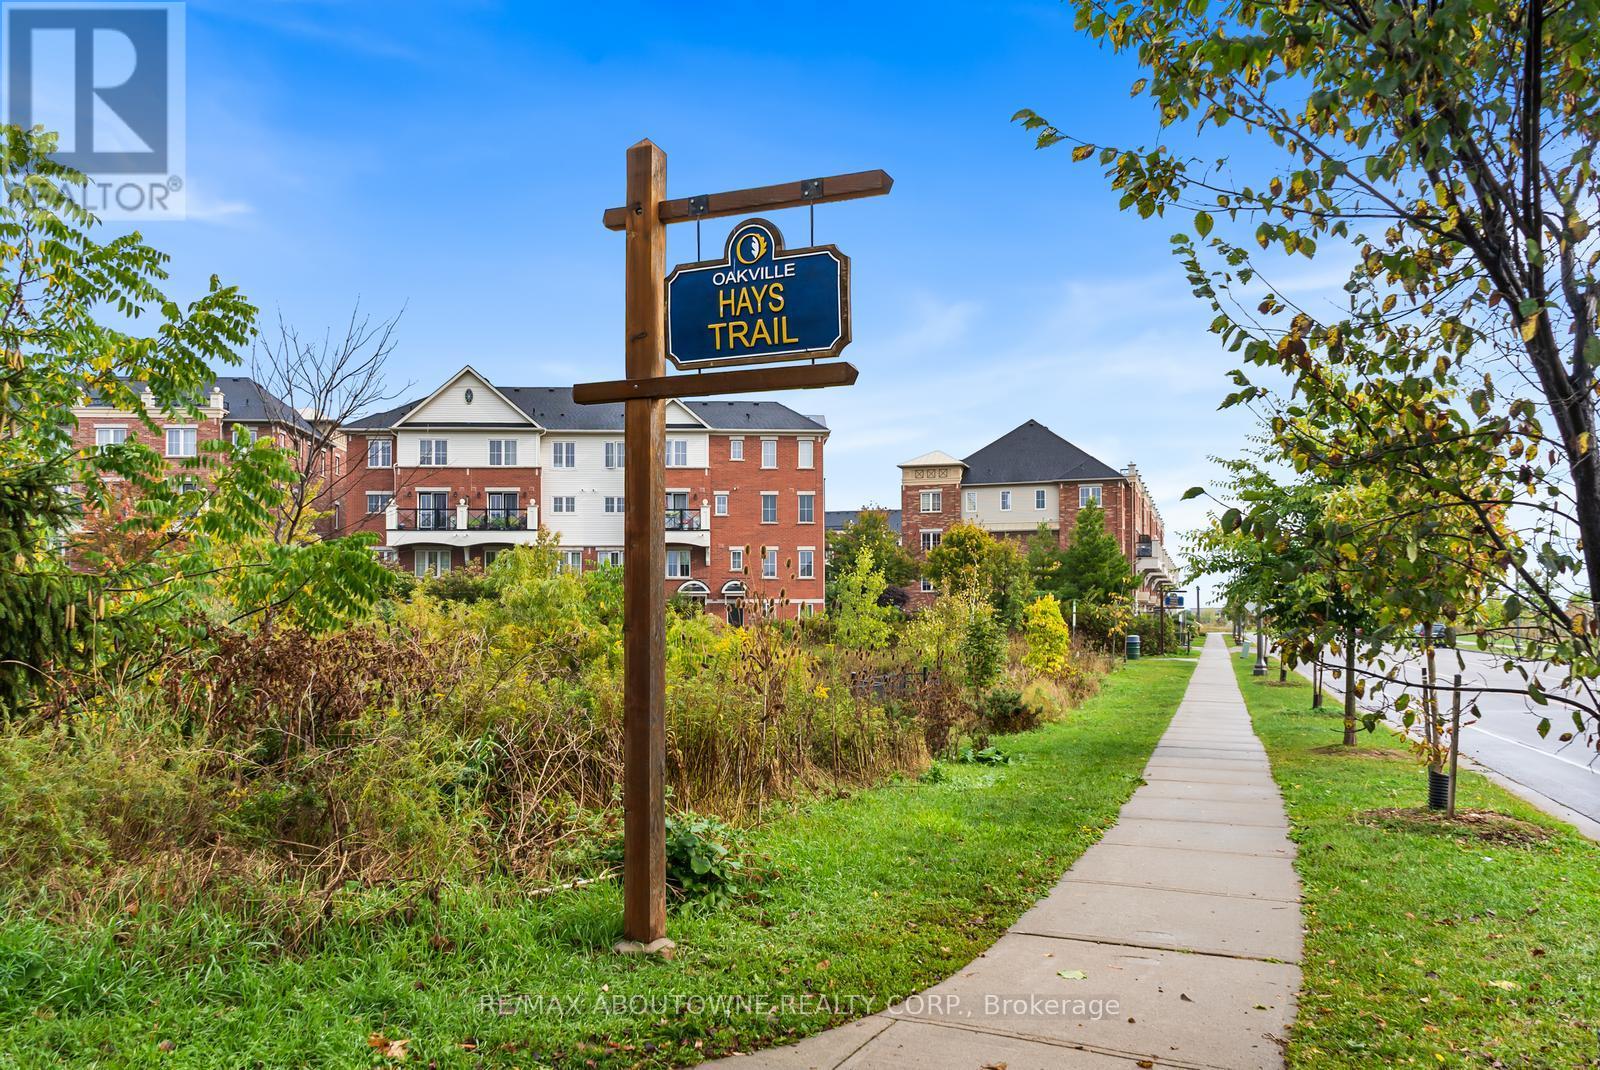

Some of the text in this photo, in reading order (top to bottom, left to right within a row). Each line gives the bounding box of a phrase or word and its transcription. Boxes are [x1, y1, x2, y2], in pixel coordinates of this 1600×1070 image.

[712, 263, 796, 286] OAKVILLE
[718, 282, 785, 318] HAYS
[707, 316, 799, 350] TRAIL
